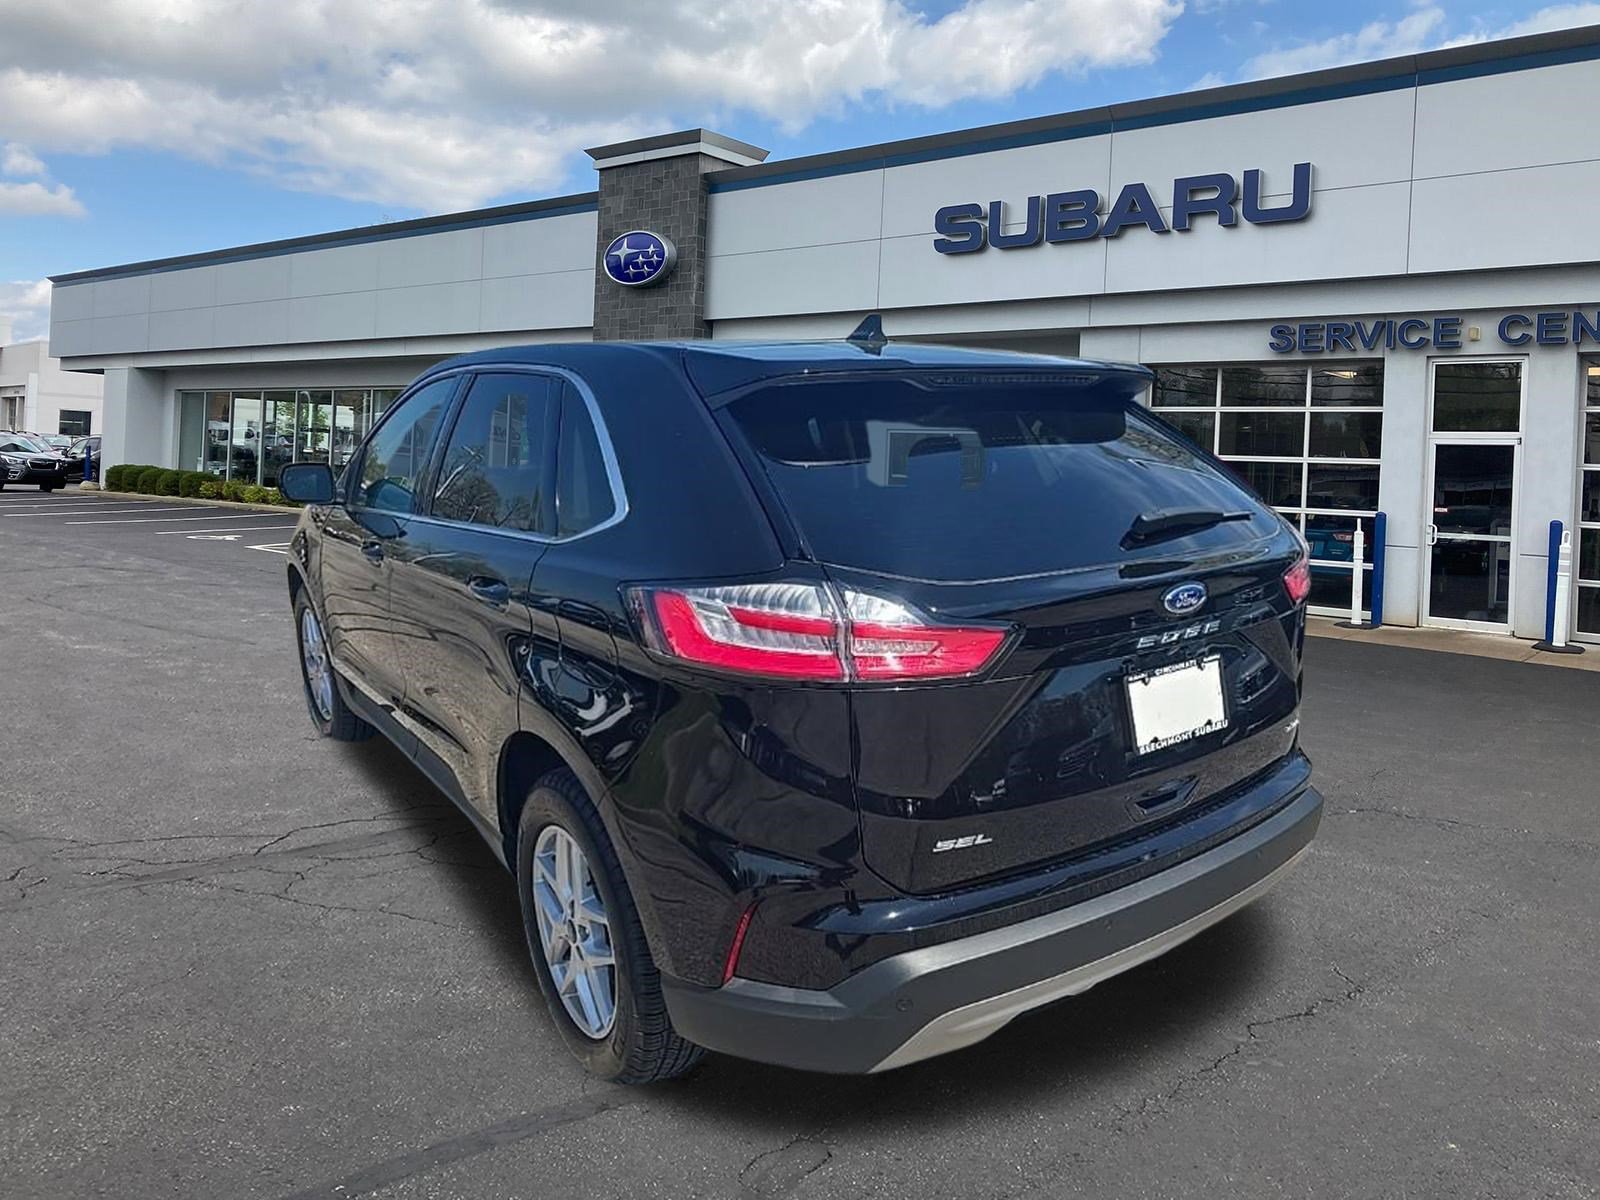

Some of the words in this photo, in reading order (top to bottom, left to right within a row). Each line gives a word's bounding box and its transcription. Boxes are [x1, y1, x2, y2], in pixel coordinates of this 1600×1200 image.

[934, 162, 1313, 255] SUBARU
[1269, 317, 1463, 353] SERVICE
[1498, 311, 1600, 347] CEN
[1137, 619, 1221, 648] EDGE
[1194, 718, 1229, 737] SUBARU
[932, 833, 993, 853] SEL
